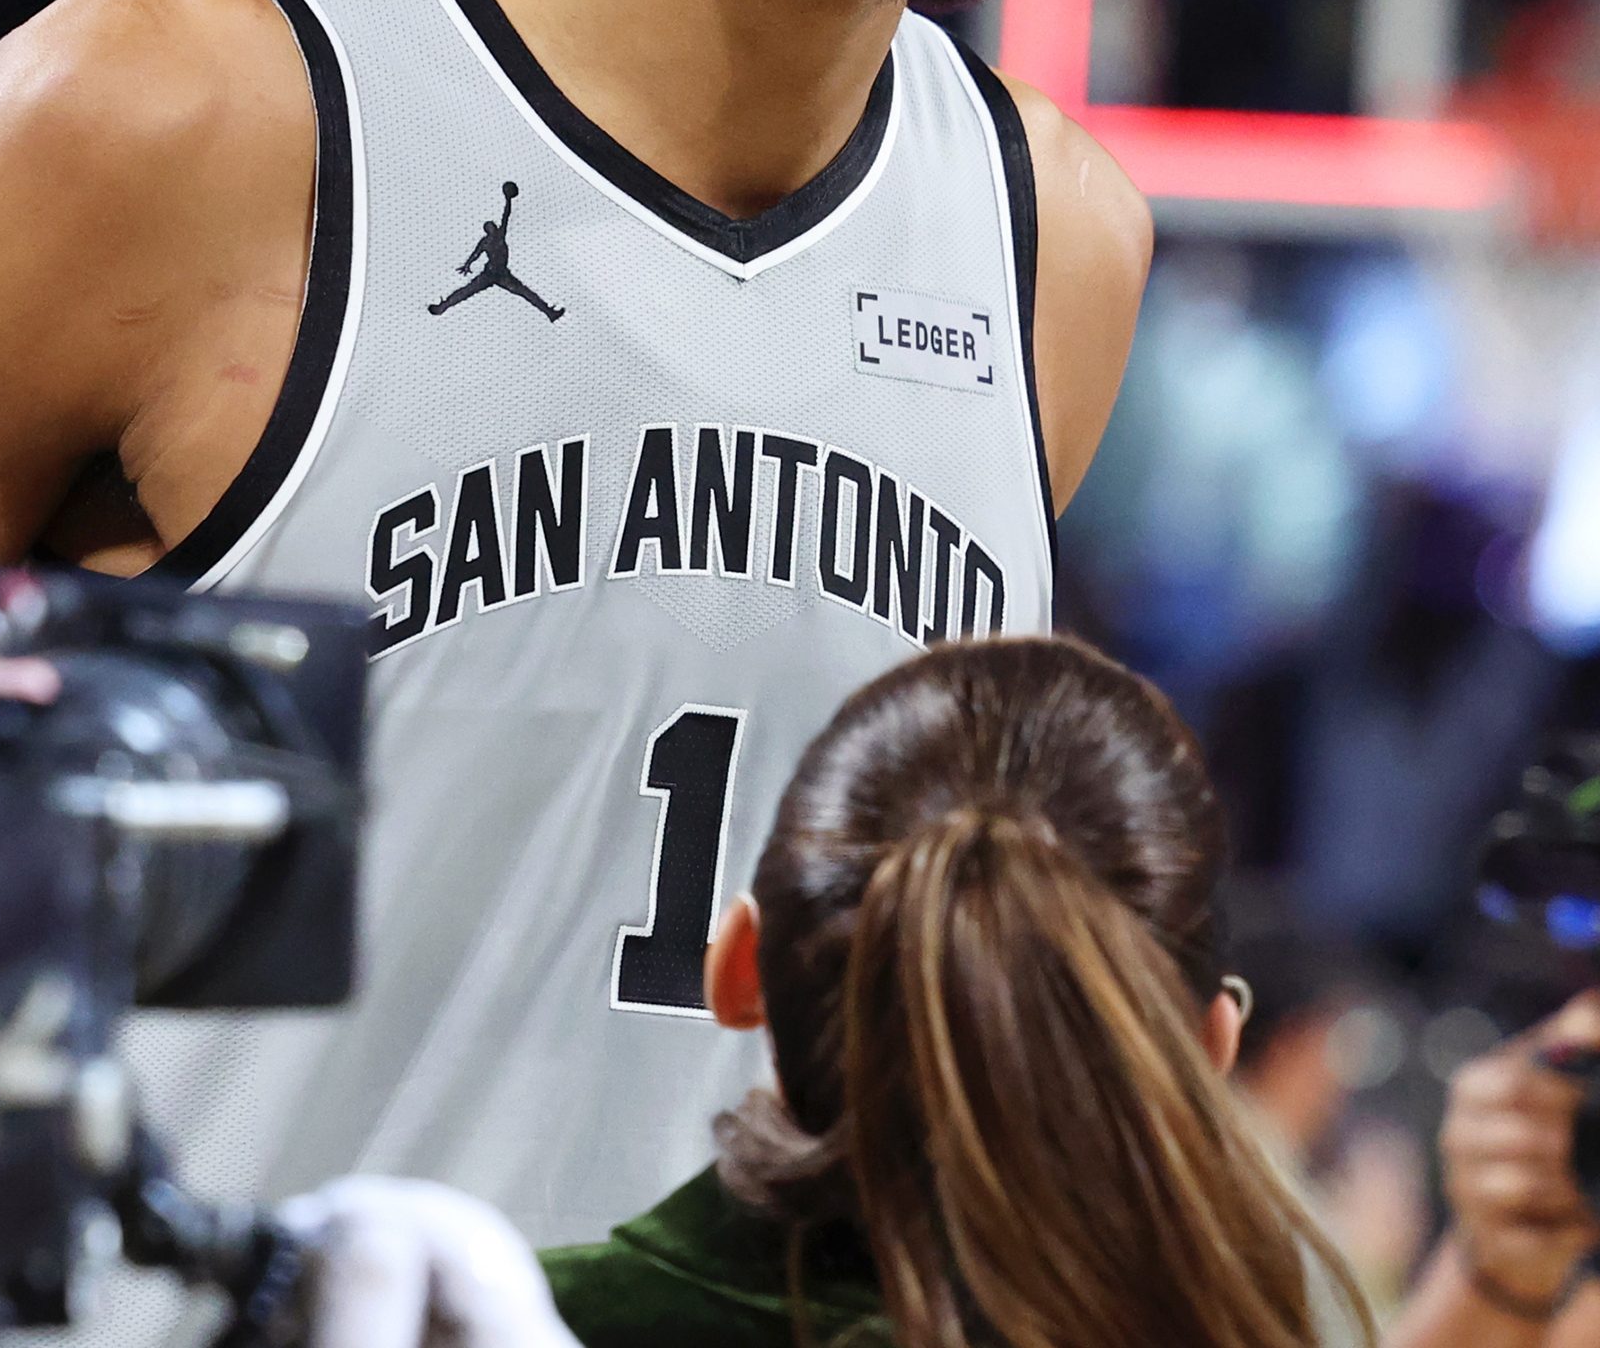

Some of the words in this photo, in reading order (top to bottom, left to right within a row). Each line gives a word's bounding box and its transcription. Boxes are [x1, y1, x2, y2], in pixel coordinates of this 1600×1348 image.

[877, 314, 977, 362] LEDGER
[365, 433, 590, 663] SAN
[610, 702, 748, 1019] 1
